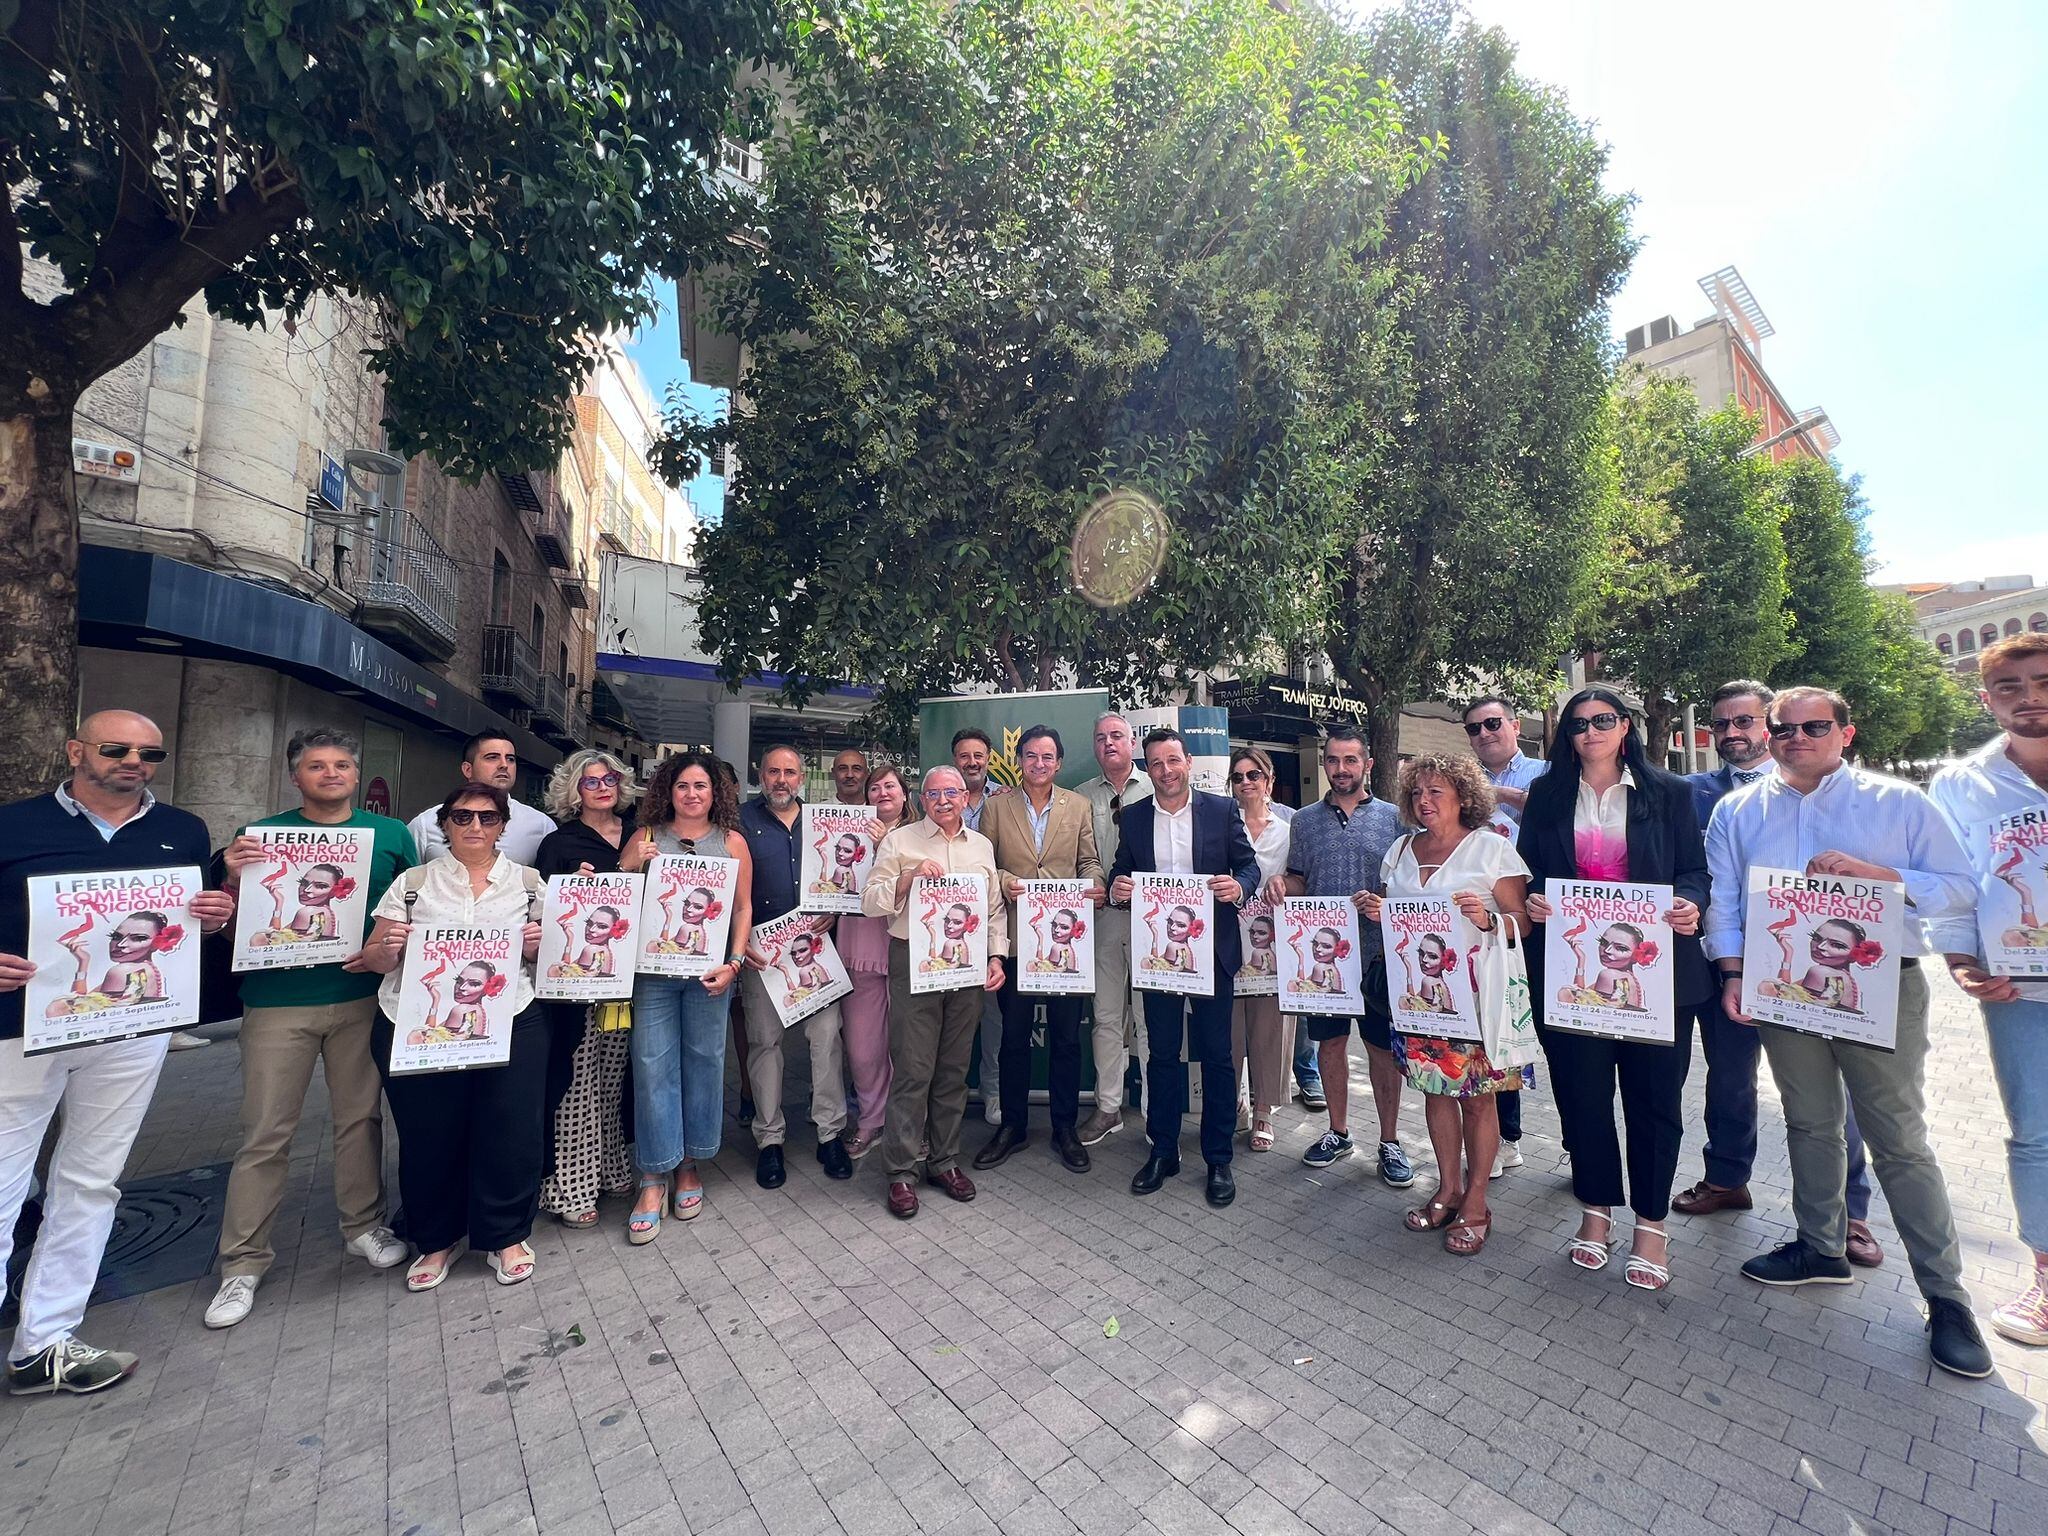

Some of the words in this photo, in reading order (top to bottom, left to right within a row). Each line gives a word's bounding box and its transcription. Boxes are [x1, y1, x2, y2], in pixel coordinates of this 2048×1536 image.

[1328, 692, 1368, 720] JOYEROS
[1184, 726, 1226, 736] www.ifeja.org
[819, 808, 851, 818] FERIA
[854, 809, 867, 818] DE
[812, 817, 868, 826] COMERCIO
[2000, 810, 2048, 829] FERI
[275, 832, 330, 844] FERIA
[336, 834, 358, 844] DE
[261, 844, 358, 855] COMERCIO
[670, 858, 708, 870] FERIA
[711, 862, 727, 872] DE
[660, 867, 727, 881] COMERCIO
[72, 876, 146, 892] FERIA
[153, 873, 180, 886] DE
[570, 877, 610, 887] FERIA
[615, 878, 632, 888] DE
[927, 878, 960, 888] FERIA
[964, 877, 977, 886] DE
[1035, 884, 1067, 892] FERIA
[1070, 884, 1084, 893] DE
[1150, 877, 1184, 888] FERIA
[1188, 879, 1203, 889] DE
[1782, 876, 1846, 895] FERIA
[1854, 884, 1883, 901] DE
[56, 884, 184, 906] COMERCIO
[559, 886, 632, 897] COMERCIO
[919, 885, 978, 897] COMERCIO
[1028, 892, 1085, 901] COMERCIO
[1142, 886, 1204, 898] COMERCIO
[1573, 885, 1625, 900] FERIA
[1632, 889, 1655, 903] DE
[1291, 901, 1327, 910] FERIA
[1330, 901, 1346, 911] DE
[1561, 897, 1656, 914] COMERCIO
[1767, 887, 1884, 913] COMERCIO
[1396, 902, 1429, 914] FERIA
[1432, 901, 1448, 913] DE
[1284, 910, 1347, 919] COMERCIO
[1390, 912, 1451, 924] COMERCIO
[759, 914, 813, 946] COMERCIO
[762, 916, 795, 937] FERIA
[436, 930, 486, 941] FERIA
[490, 929, 510, 940] DE
[306, 938, 349, 950] Septiembre
[423, 940, 510, 952] COMERCIO
[64, 1015, 78, 1024] 22
[93, 1011, 107, 1019] 24
[124, 998, 180, 1016] Septiembre
[1570, 1004, 1580, 1012] 22
[1613, 1010, 1658, 1021] Septiembre
[1772, 998, 1783, 1007] 22
[1795, 1003, 1807, 1011] 24
[1821, 1008, 1876, 1025] Septiembre
[458, 1038, 498, 1049] Septiembre
